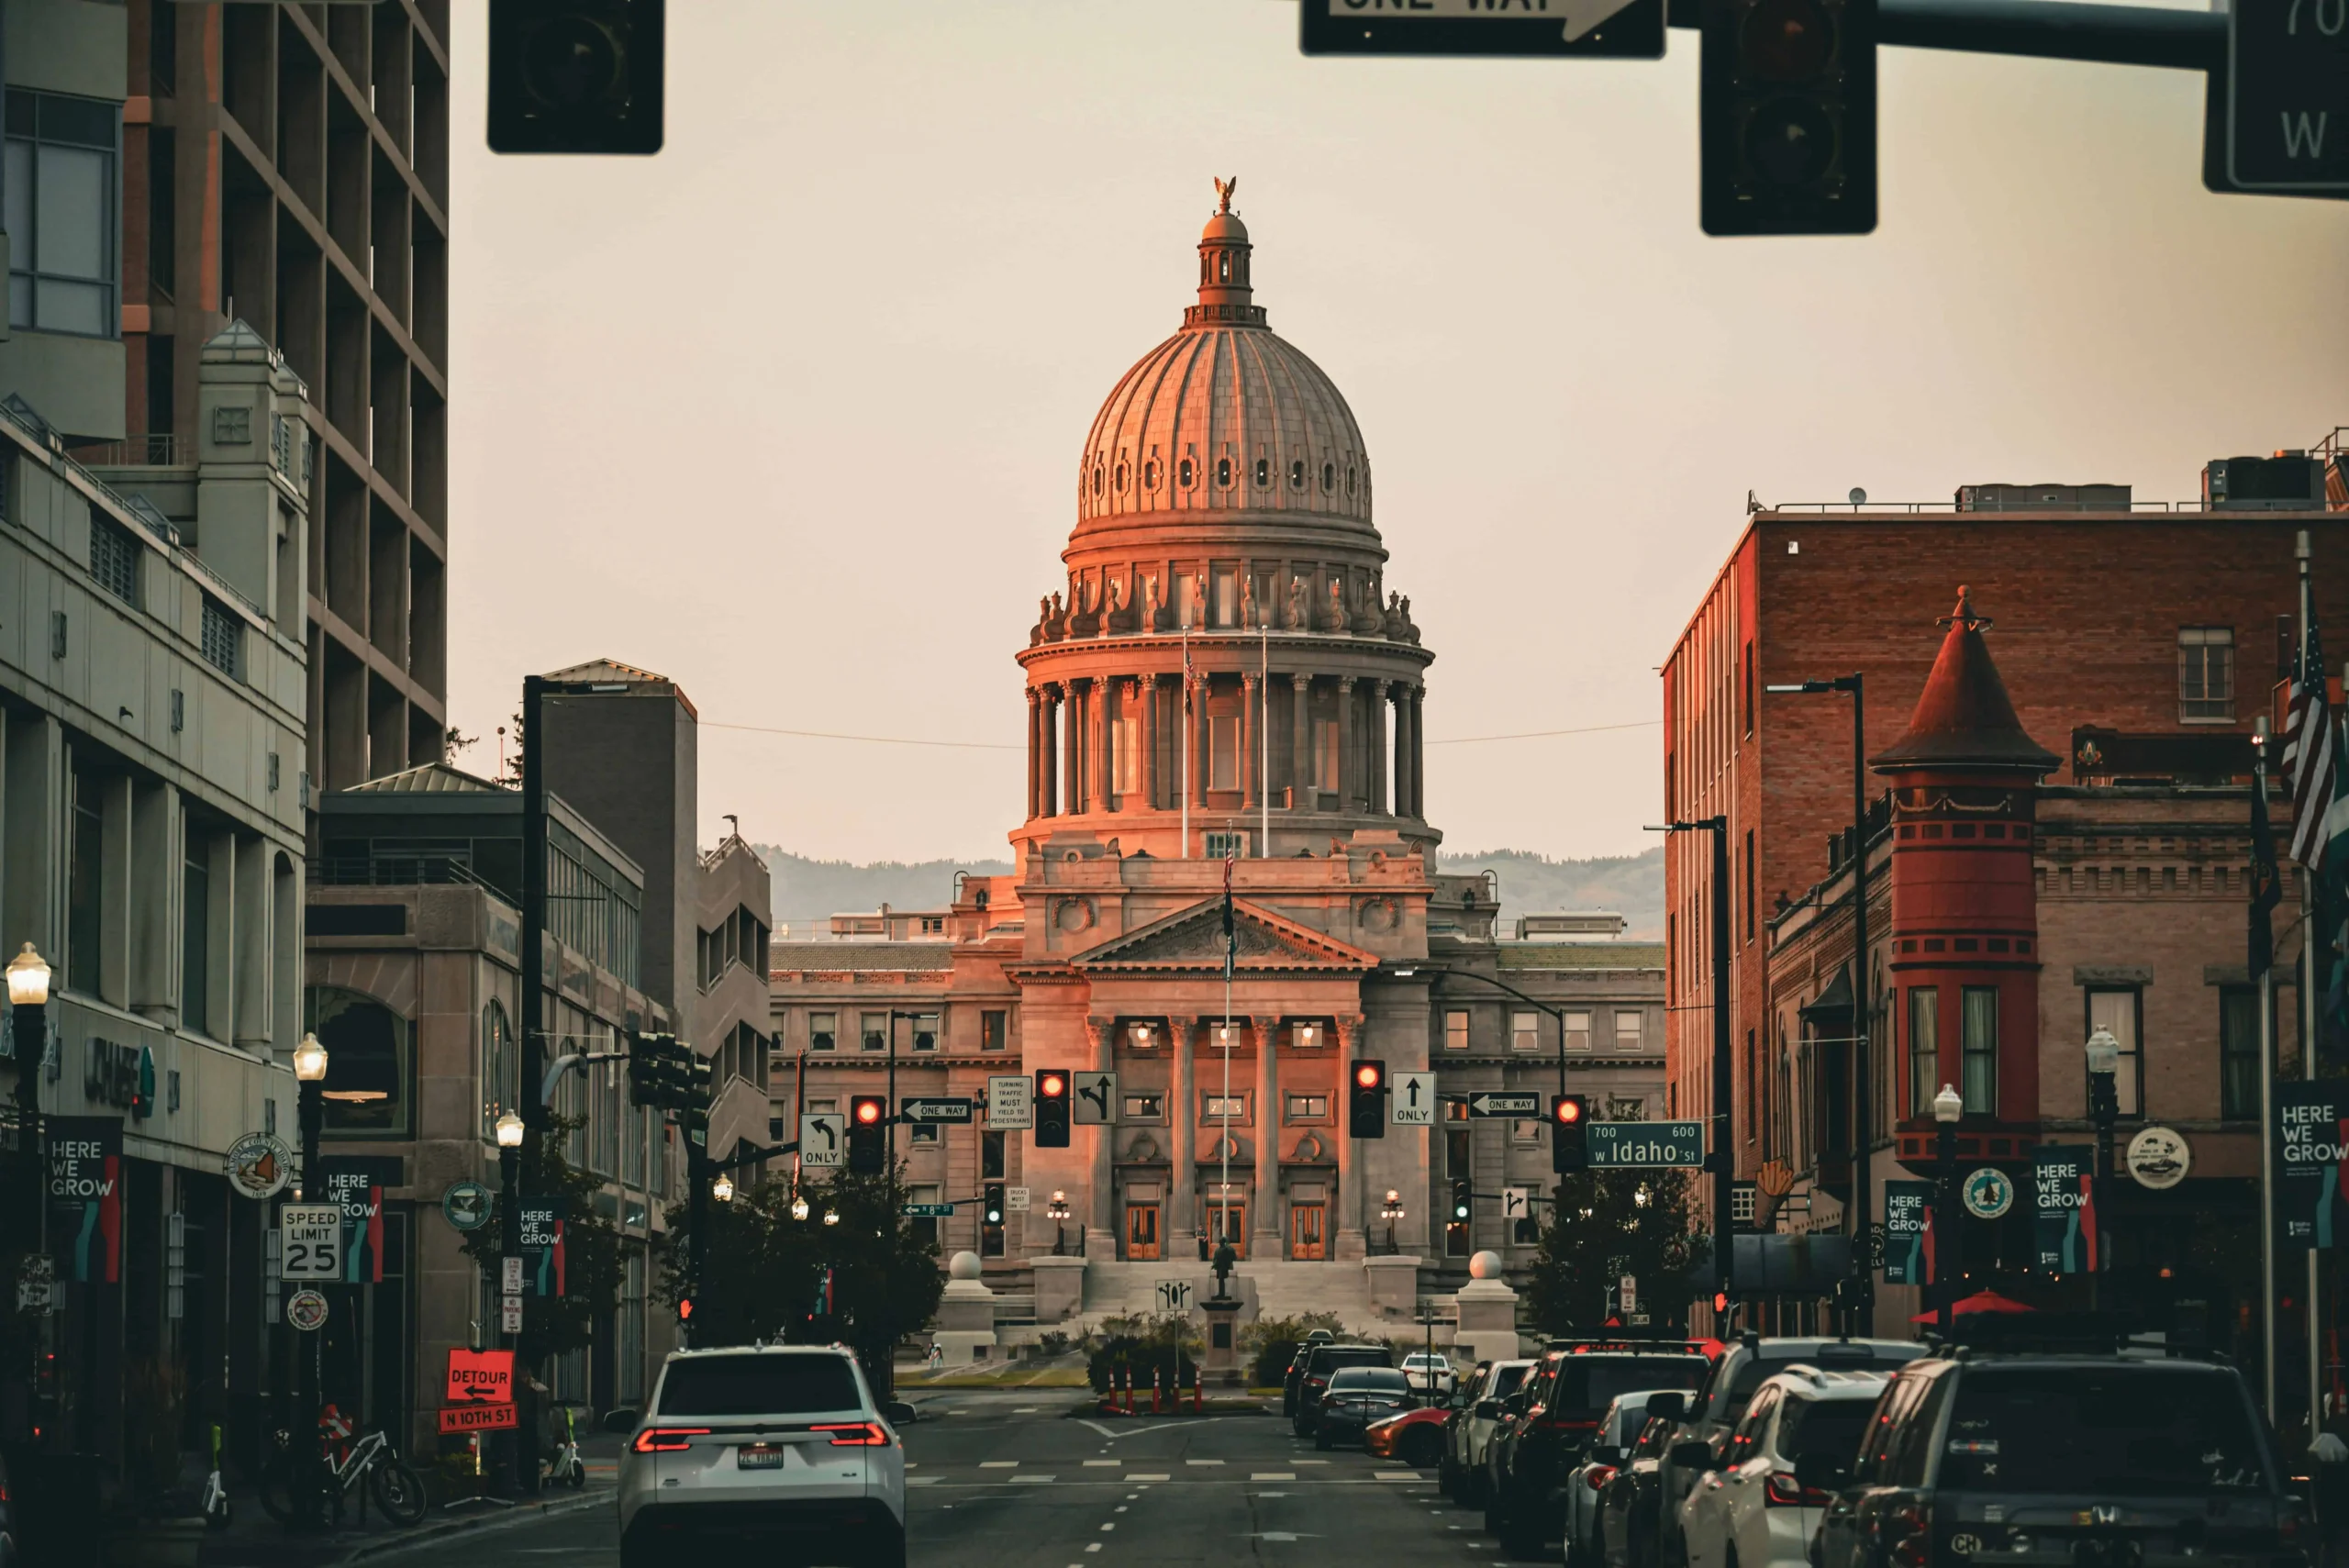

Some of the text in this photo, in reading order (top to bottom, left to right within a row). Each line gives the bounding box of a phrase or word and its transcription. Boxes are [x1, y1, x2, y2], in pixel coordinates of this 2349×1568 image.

[2280, 111, 2328, 159] W
[921, 1106, 964, 1115] ONE WAY
[1489, 1100, 1532, 1109] ONE WAY
[1397, 1110, 1429, 1120] ONLY
[2282, 1105, 2334, 1124] HERE
[1595, 1126, 1695, 1138] 700 600
[2281, 1125, 2312, 1143] WE
[52, 1141, 102, 1159] HERE
[1612, 1140, 1676, 1162] Idaho
[1684, 1151, 1696, 1162] St
[2283, 1142, 2349, 1162] GROW
[806, 1152, 839, 1163] ONLY
[51, 1160, 79, 1177] WE
[2036, 1163, 2076, 1179] HERE
[51, 1179, 114, 1196] GROW
[328, 1174, 368, 1188] HERE
[2036, 1179, 2061, 1193] WE
[328, 1189, 351, 1202] WE
[1889, 1195, 1922, 1207] HERE
[2037, 1193, 2088, 1207] GROW
[341, 1203, 378, 1217] ROW
[521, 1211, 552, 1222] HERE
[1888, 1207, 1909, 1219] WE
[285, 1213, 338, 1225] SPEED
[1888, 1219, 1931, 1231] GROW
[291, 1229, 331, 1240] LIMIT
[520, 1222, 540, 1233] WE
[520, 1233, 561, 1245] GROW
[286, 1244, 336, 1272] 25
[451, 1370, 507, 1385] DETOUR
[447, 1408, 512, 1426] N 10TH ST
[1955, 1533, 1976, 1551] CH
